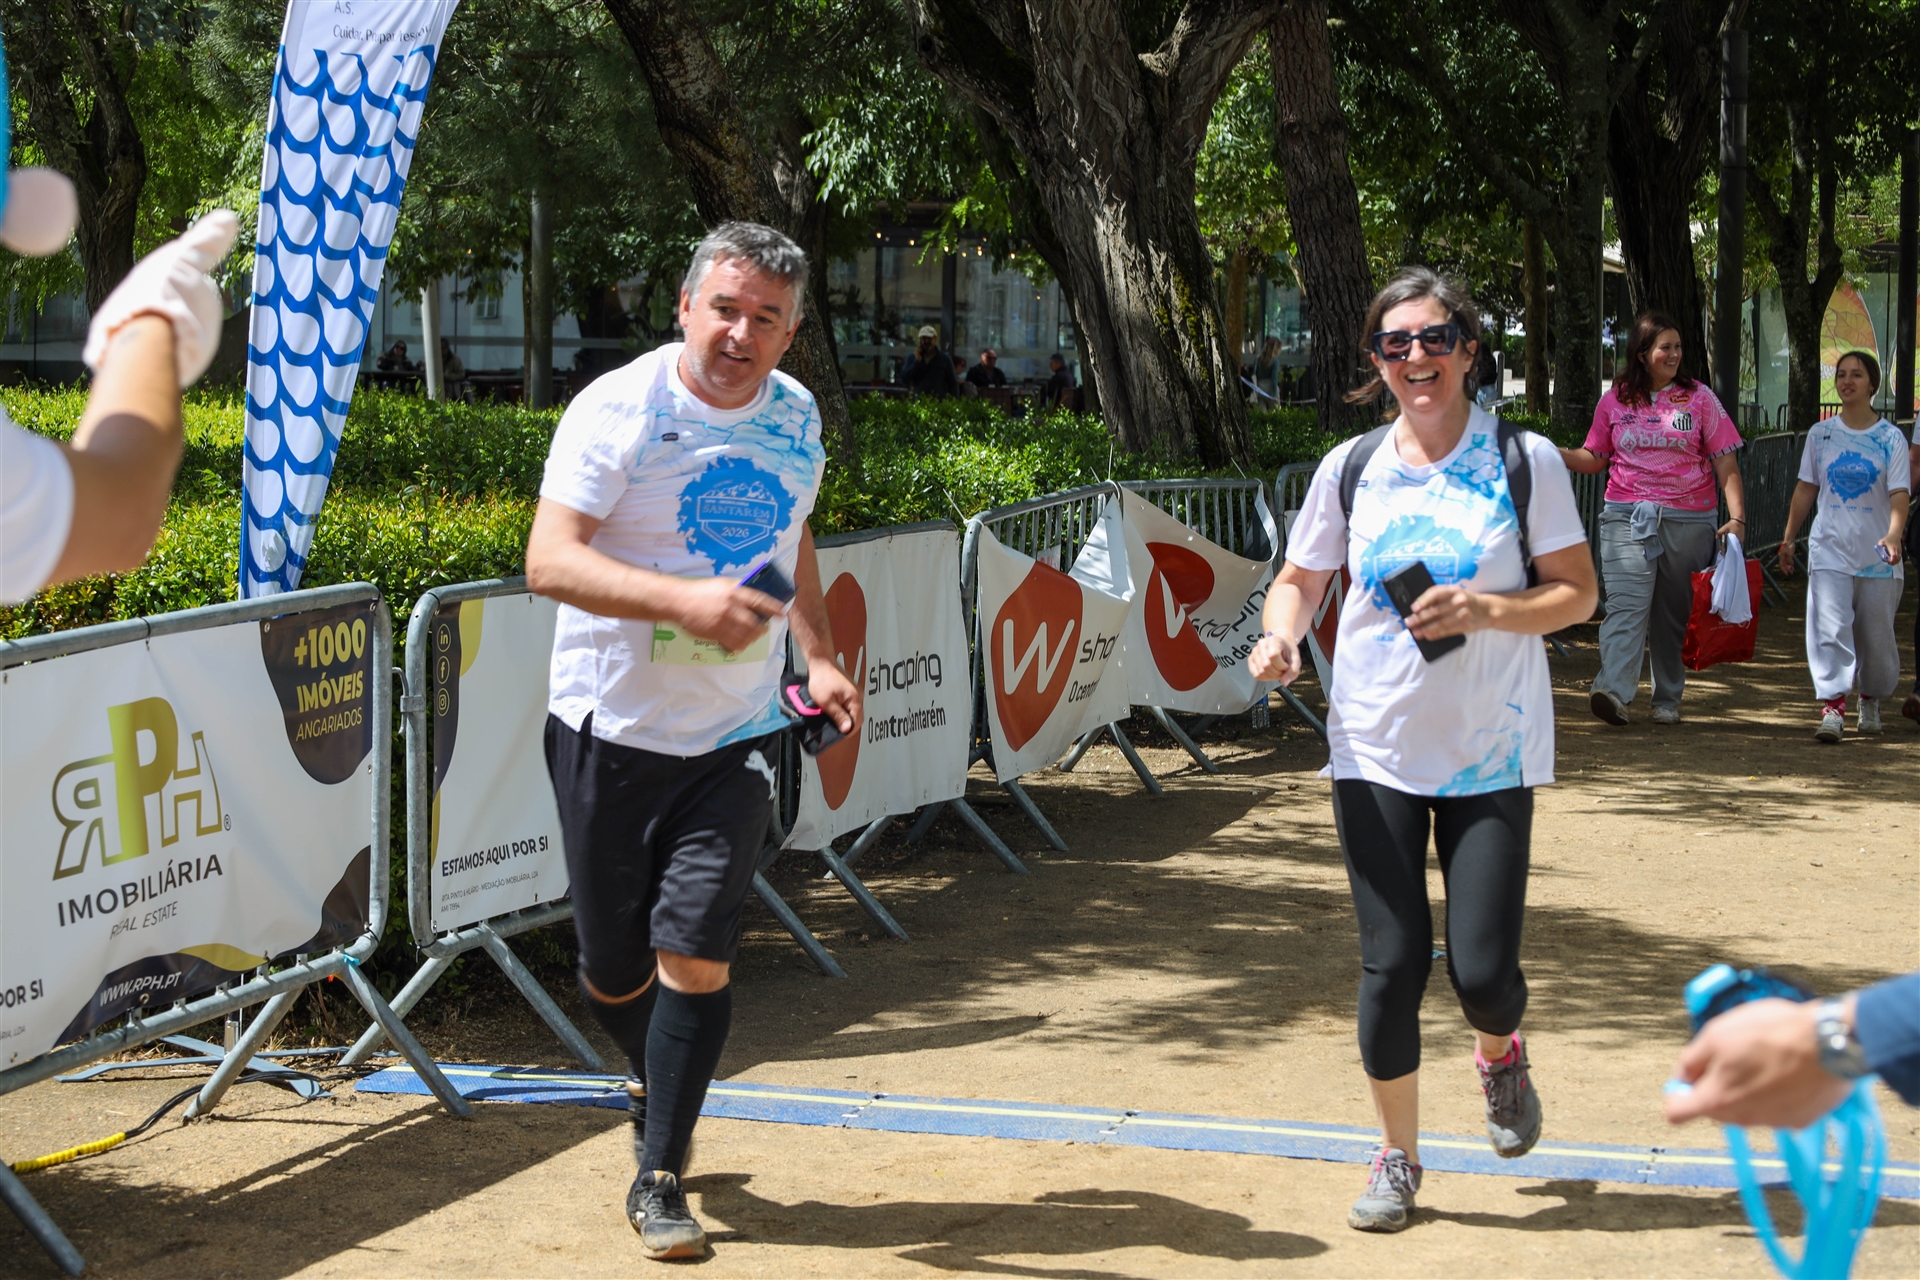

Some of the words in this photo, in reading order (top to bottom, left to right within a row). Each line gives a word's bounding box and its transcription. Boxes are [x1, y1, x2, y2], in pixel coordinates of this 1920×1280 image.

[1639, 433, 1688, 448] blaze
[702, 503, 771, 519] SANTARÉM
[721, 526, 750, 539] 2026
[294, 618, 367, 669] +1000
[296, 670, 364, 713] IMÓVEIS
[295, 707, 363, 742] ANGARIADOS
[874, 714, 908, 742] centro
[442, 850, 485, 877] ESTAMOS
[485, 843, 511, 865] AQUI
[511, 838, 538, 858] POR
[538, 835, 549, 852] SI
[57, 853, 223, 928] IMOBILIÁRIA
[480, 877, 506, 892] MEDIAÇÃO
[109, 915, 138, 941] REAL
[142, 901, 179, 928] ESTATE
[30, 978, 43, 1000] SI
[100, 971, 182, 1008] WWW.RPH.PT
